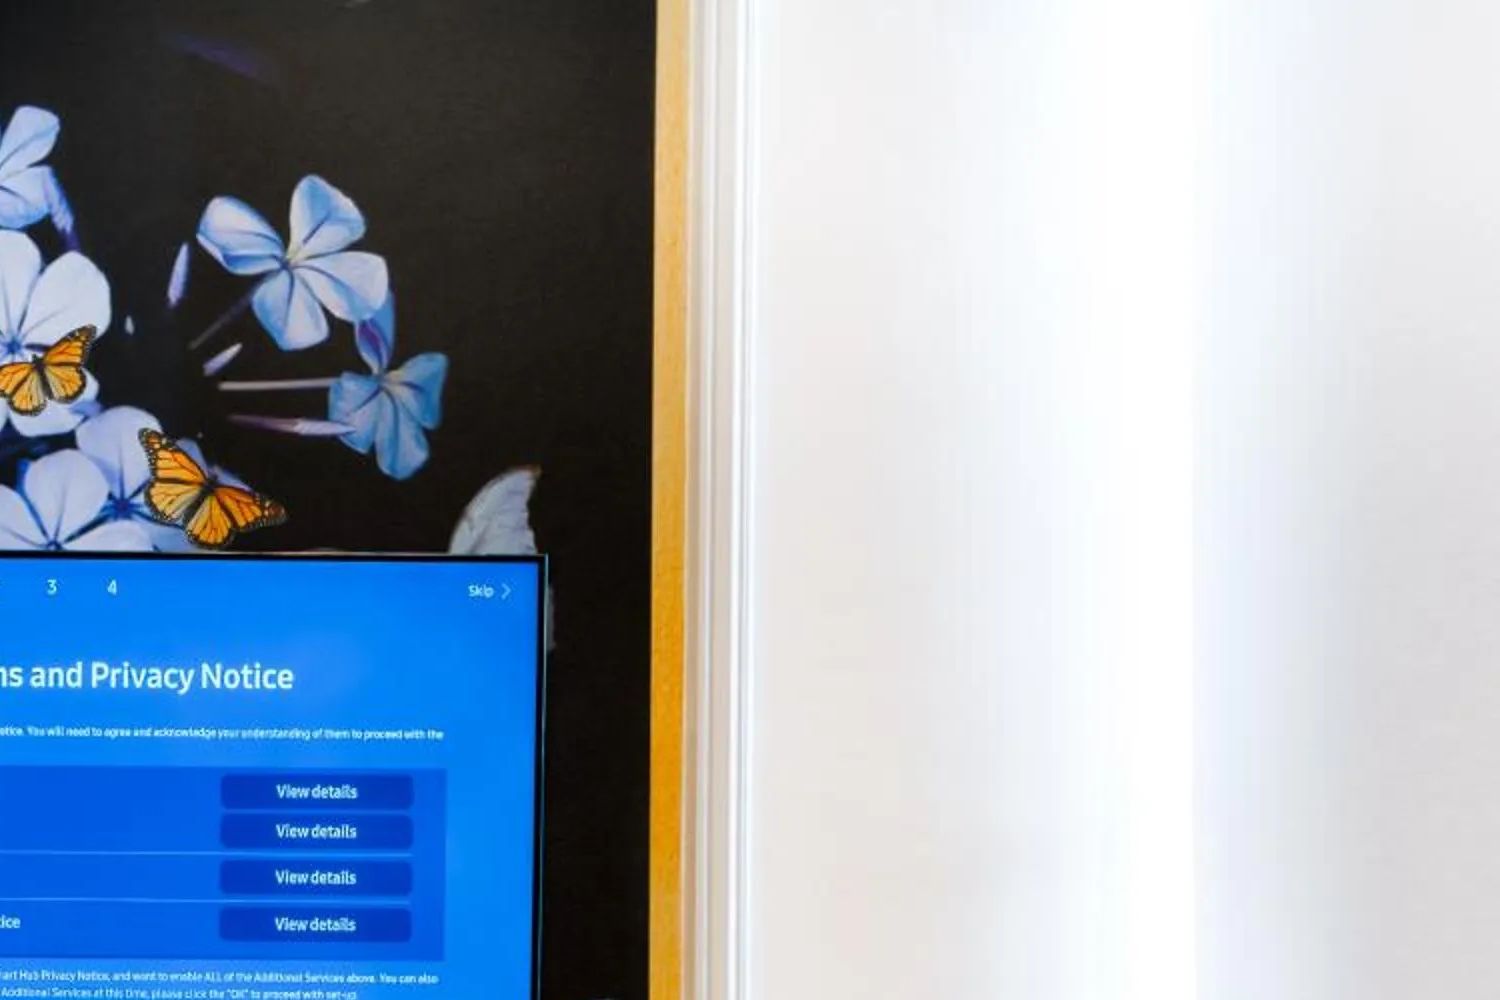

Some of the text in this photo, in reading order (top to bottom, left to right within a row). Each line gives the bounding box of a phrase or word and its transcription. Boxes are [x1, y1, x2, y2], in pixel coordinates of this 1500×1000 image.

[47, 578, 58, 595] 3
[106, 579, 118, 595] 4
[468, 584, 494, 599] Skip
[28, 660, 84, 689] and
[90, 661, 196, 696] Privacy
[201, 662, 294, 690] Notice
[27, 726, 45, 736] You
[46, 726, 64, 736] will
[66, 726, 90, 736] need
[92, 726, 102, 736] to
[104, 726, 131, 739] agree
[133, 727, 151, 737] and
[153, 727, 216, 739] acknowledge
[217, 727, 239, 740] your
[241, 727, 310, 740] understanding
[312, 728, 323, 738] of
[324, 728, 350, 738] them
[351, 728, 362, 738] to
[363, 728, 402, 741] proceed
[403, 728, 425, 738] with
[427, 728, 445, 738] the
[275, 783, 358, 800] View details
[275, 823, 357, 839] View details
[275, 869, 357, 885] View details
[274, 917, 357, 932] View details
